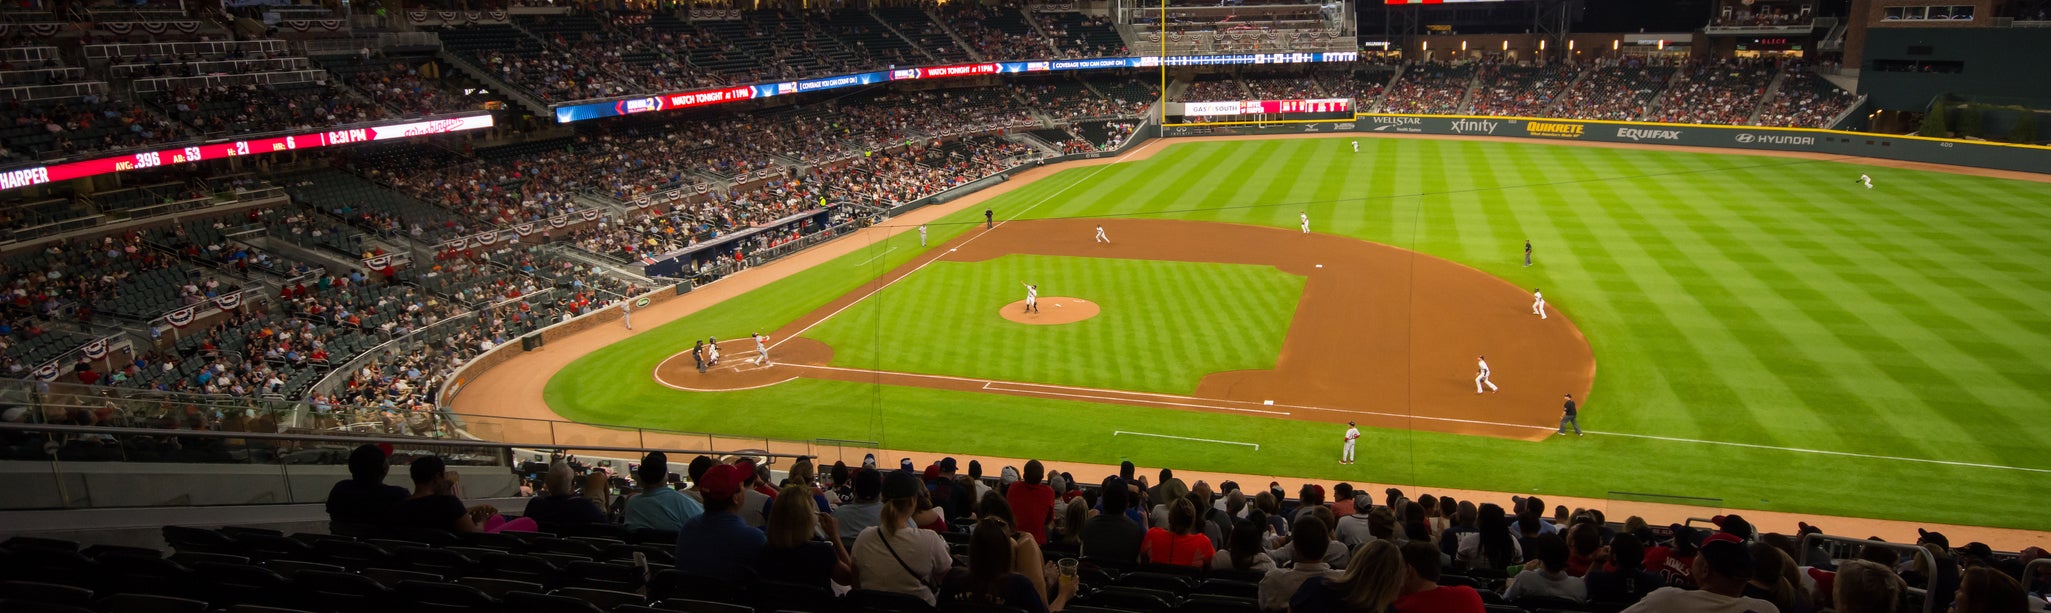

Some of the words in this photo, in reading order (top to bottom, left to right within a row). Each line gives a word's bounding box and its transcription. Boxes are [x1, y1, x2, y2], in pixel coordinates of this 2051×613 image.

[928, 67, 947, 76] WATCH
[947, 66, 970, 75] TONIGHT
[977, 64, 993, 73] 11PM
[671, 95, 695, 106] WATCH
[694, 91, 723, 104] TONIGHT
[732, 88, 749, 99] 11PM
[404, 116, 465, 136] Washington
[1373, 116, 1422, 125] WELLSTAR
[1451, 118, 1497, 134] xfinity
[1527, 121, 1585, 134] QUIKRETE
[1616, 127, 1681, 140] EQUIFAX
[1758, 134, 1815, 145] HYUNDAI
[0, 167, 49, 190] HARPER
[116, 161, 133, 171] AVG:
[135, 152, 161, 170] .396
[174, 154, 186, 164] AB:
[185, 147, 202, 161] 53
[228, 148, 236, 157] H:
[237, 141, 250, 156] 21
[273, 142, 287, 151] HR:
[287, 137, 296, 150] 6
[330, 129, 350, 144] 8:31
[350, 128, 367, 143] PM
